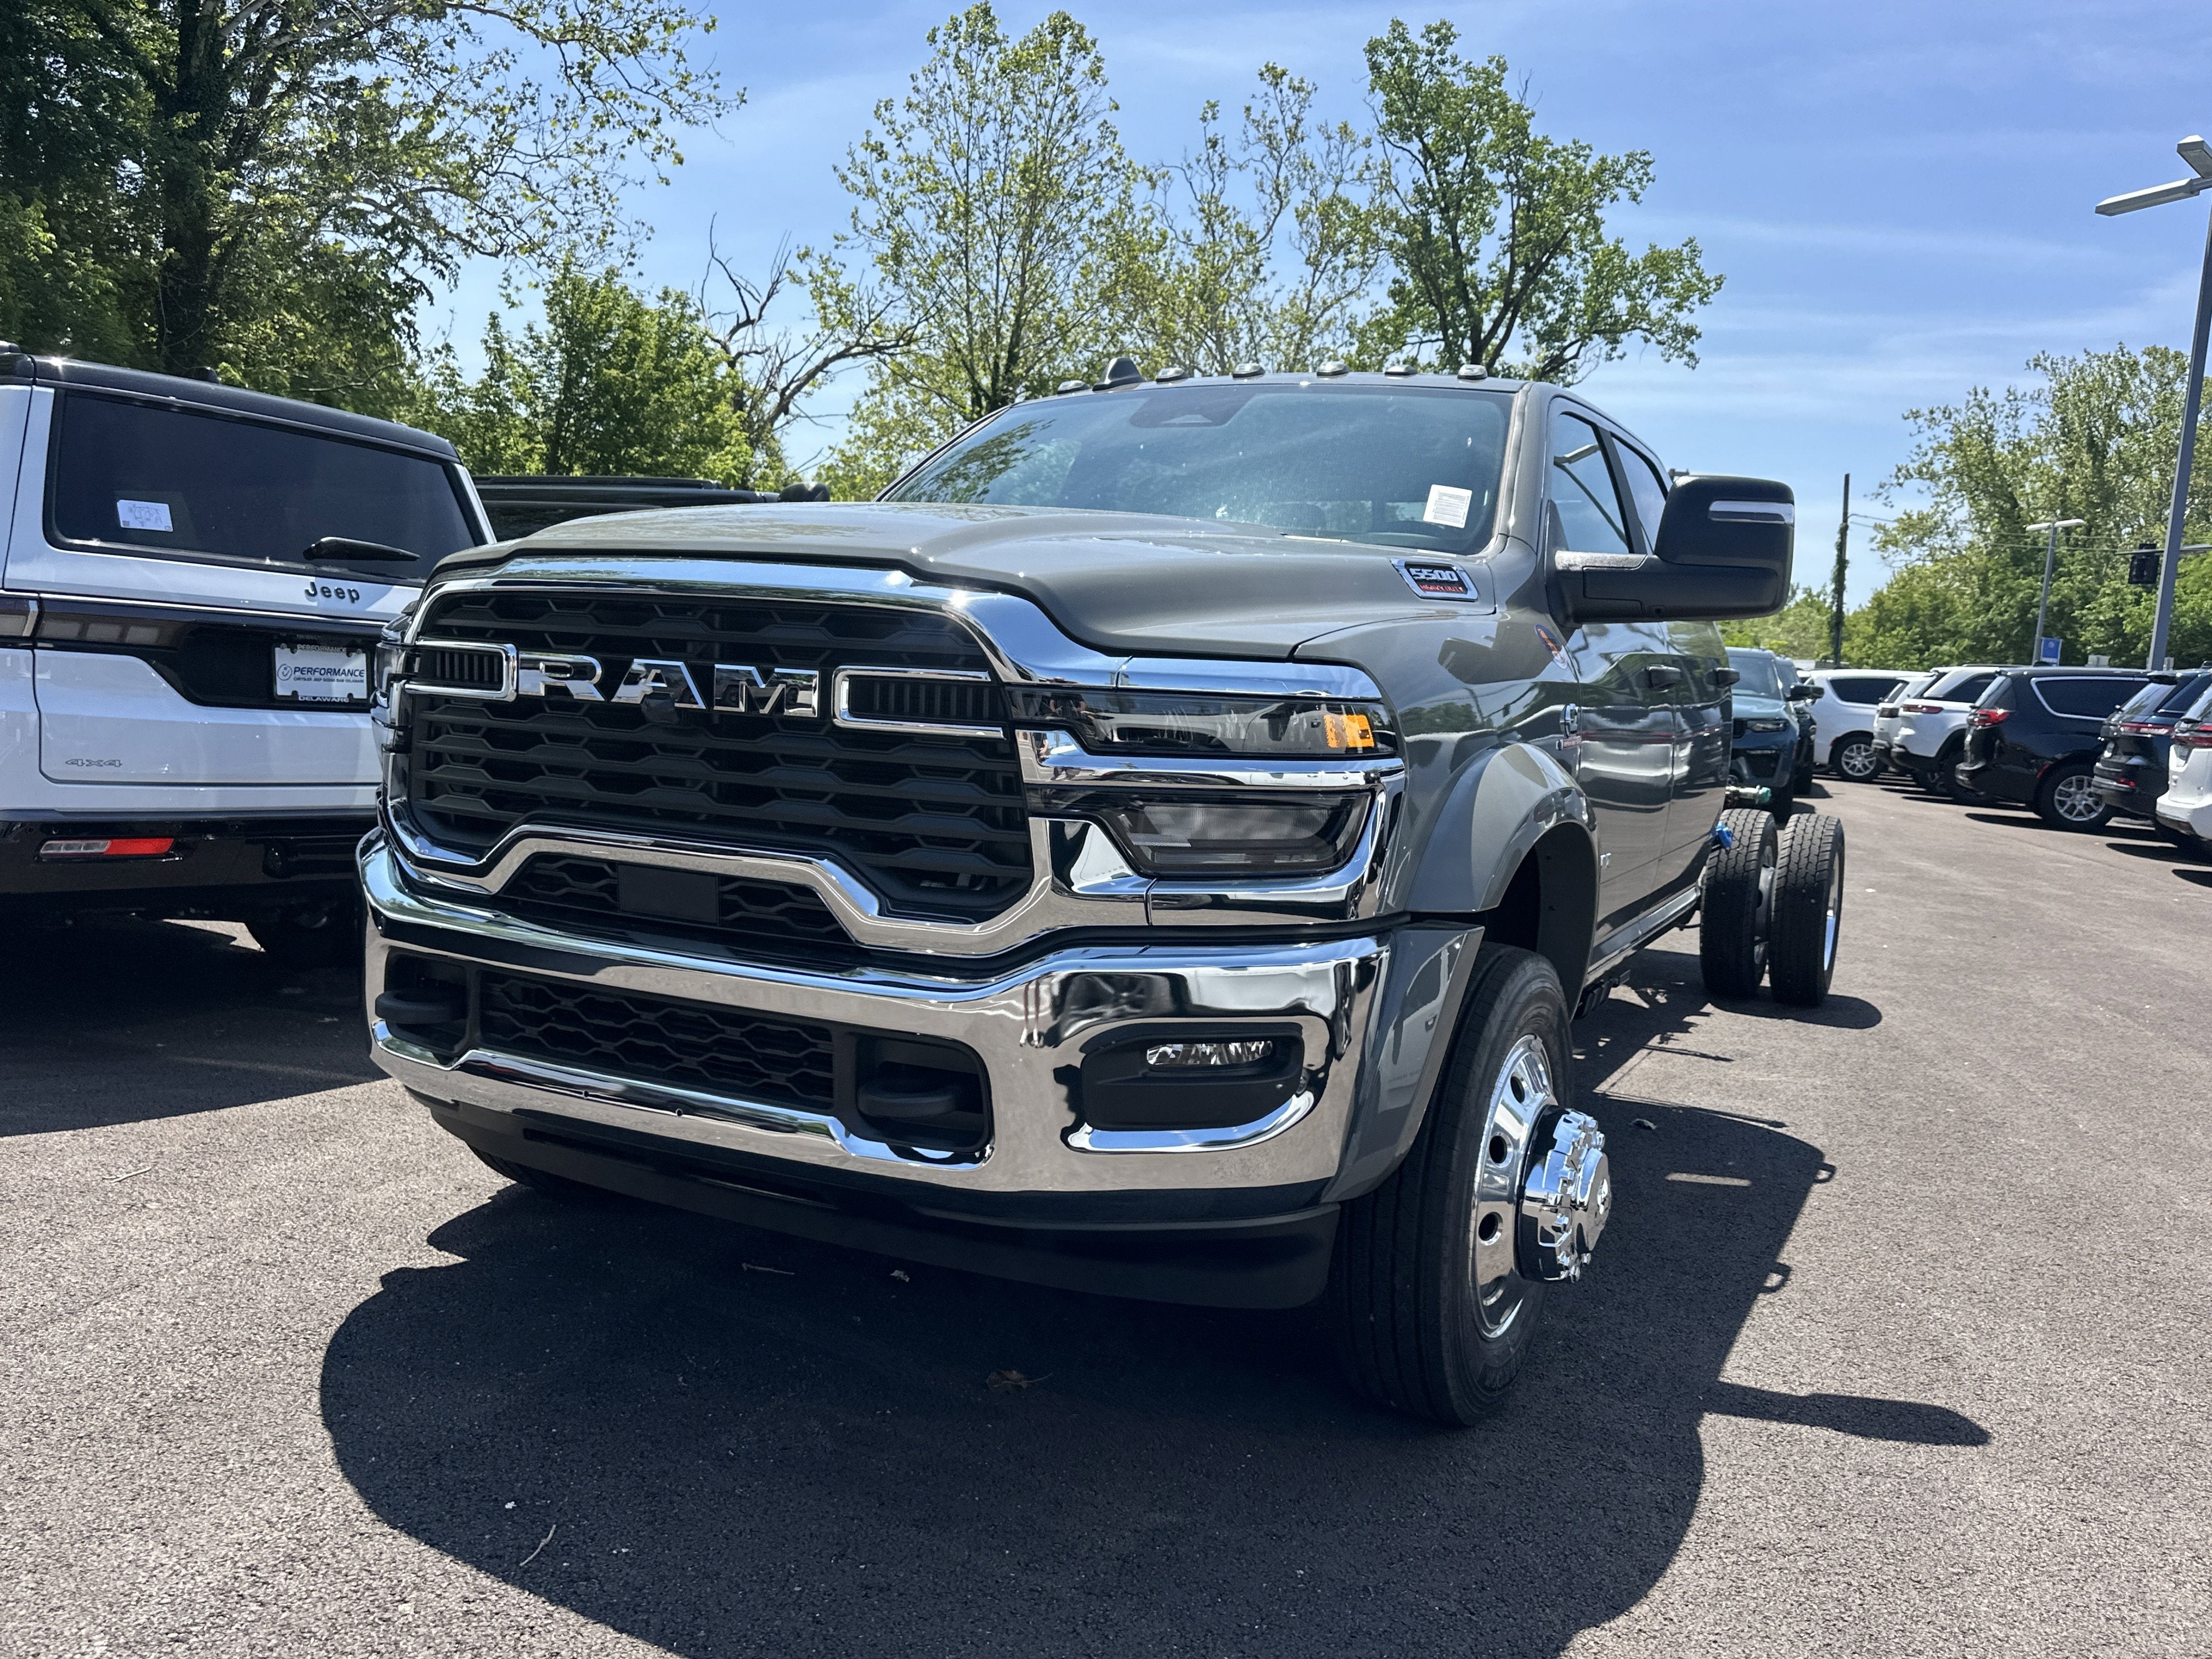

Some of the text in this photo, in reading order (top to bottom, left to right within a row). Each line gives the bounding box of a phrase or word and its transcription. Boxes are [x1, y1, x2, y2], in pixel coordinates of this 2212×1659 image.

[1409, 568, 1458, 582] 5500
[304, 581, 360, 603] Jeep
[297, 644, 347, 653] PERFORMANCE
[294, 667, 365, 678] PERFORMANCE
[518, 651, 820, 718] RAM
